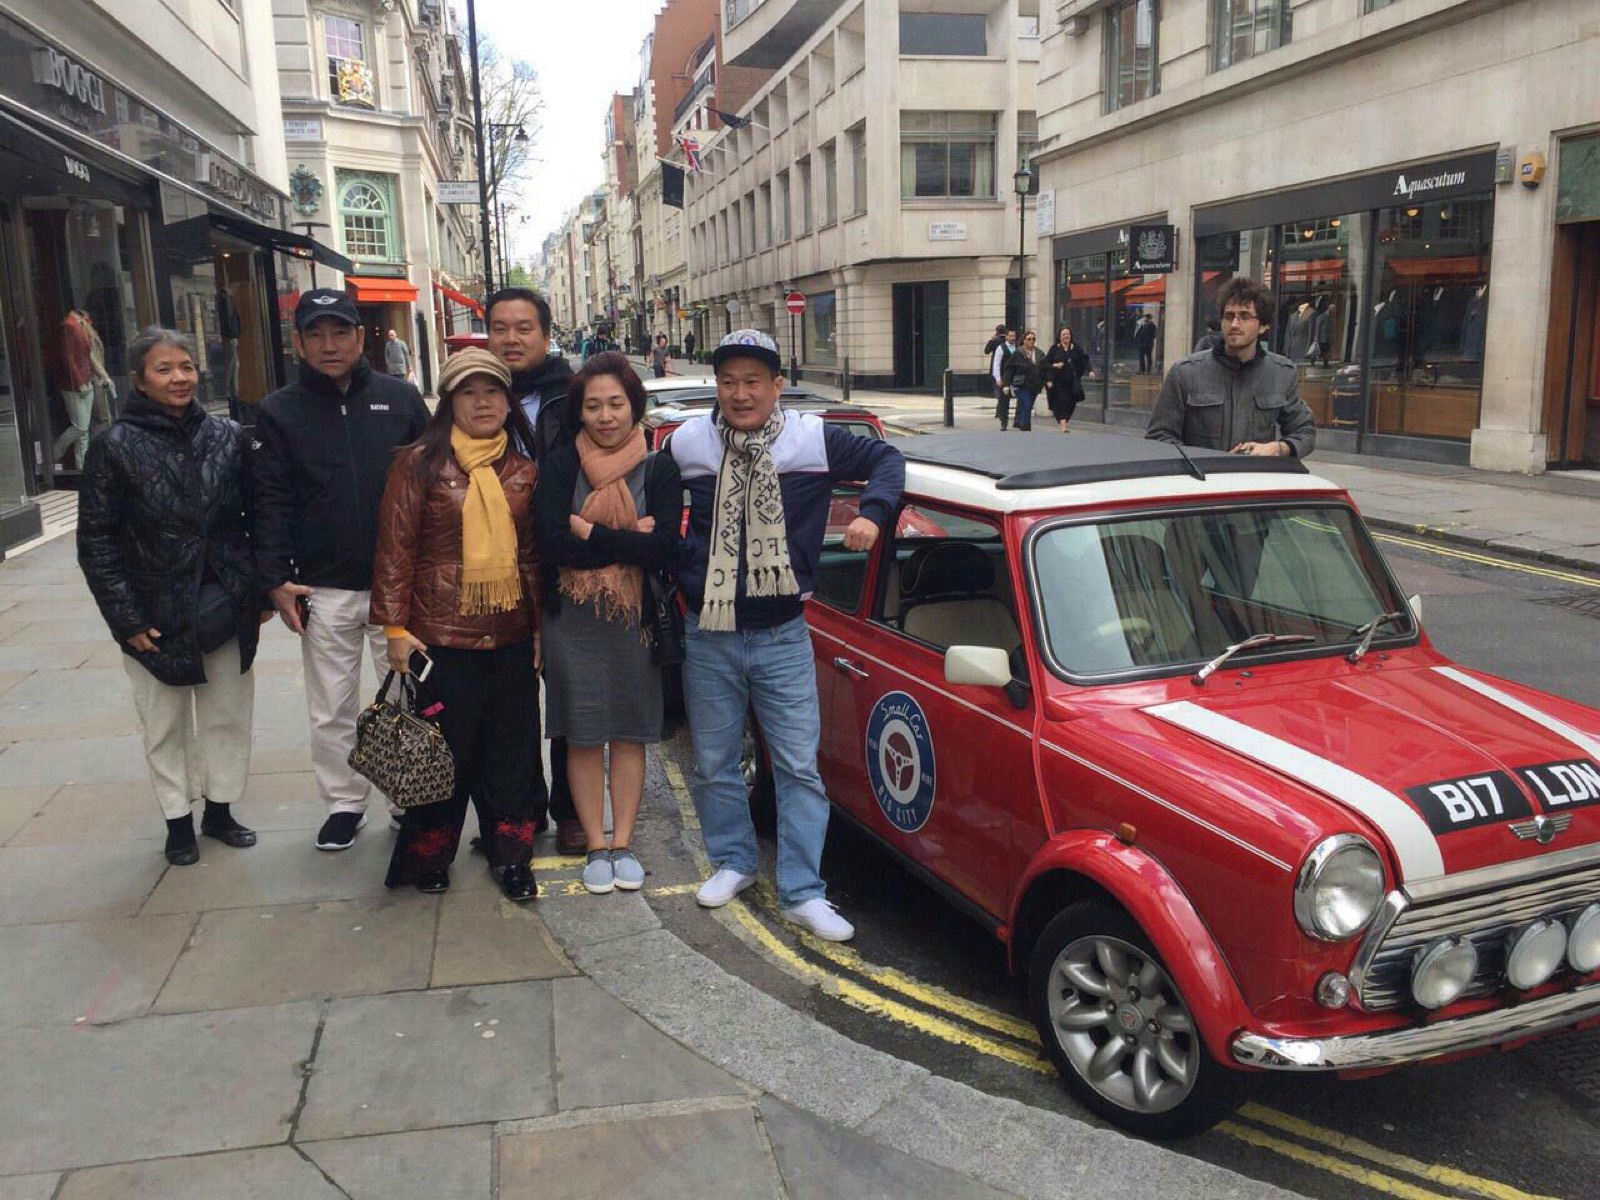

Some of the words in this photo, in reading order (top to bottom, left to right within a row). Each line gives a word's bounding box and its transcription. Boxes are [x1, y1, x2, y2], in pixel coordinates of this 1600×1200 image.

[40, 47, 106, 115] BOGGI
[1392, 171, 1466, 200] Aquascutum
[370, 403, 390, 411] MINI
[880, 702, 911, 721] Small
[909, 713, 923, 740] Car
[1428, 776, 1504, 823] B17
[1524, 763, 1600, 806] LDN
[895, 808, 917, 825] CITY
